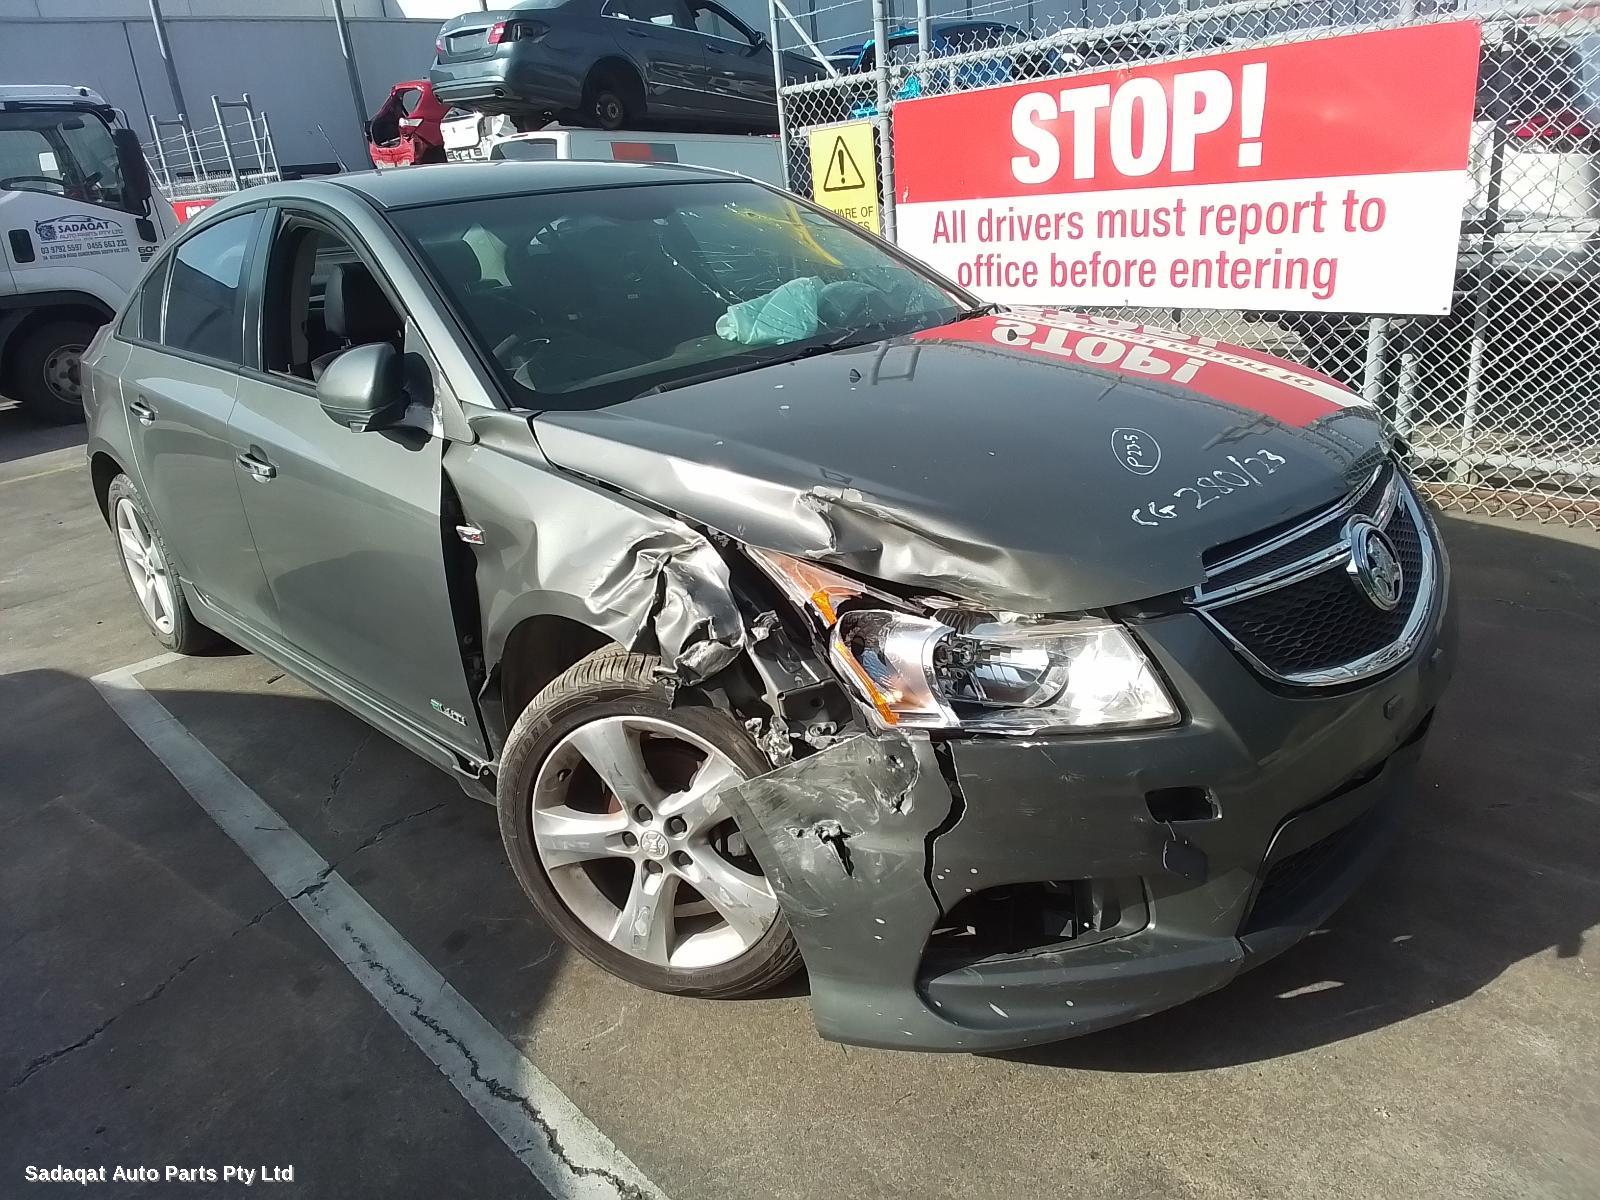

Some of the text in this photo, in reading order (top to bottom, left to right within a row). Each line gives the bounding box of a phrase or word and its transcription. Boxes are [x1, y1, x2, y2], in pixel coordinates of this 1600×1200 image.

[1011, 62, 1268, 184] STOP!
[58, 222, 109, 234] SADAQAT
[861, 206, 874, 217] OF
[933, 190, 1386, 244] All drivers must report to
[958, 248, 1338, 300] office before entering
[1173, 449, 1287, 510] 280/23
